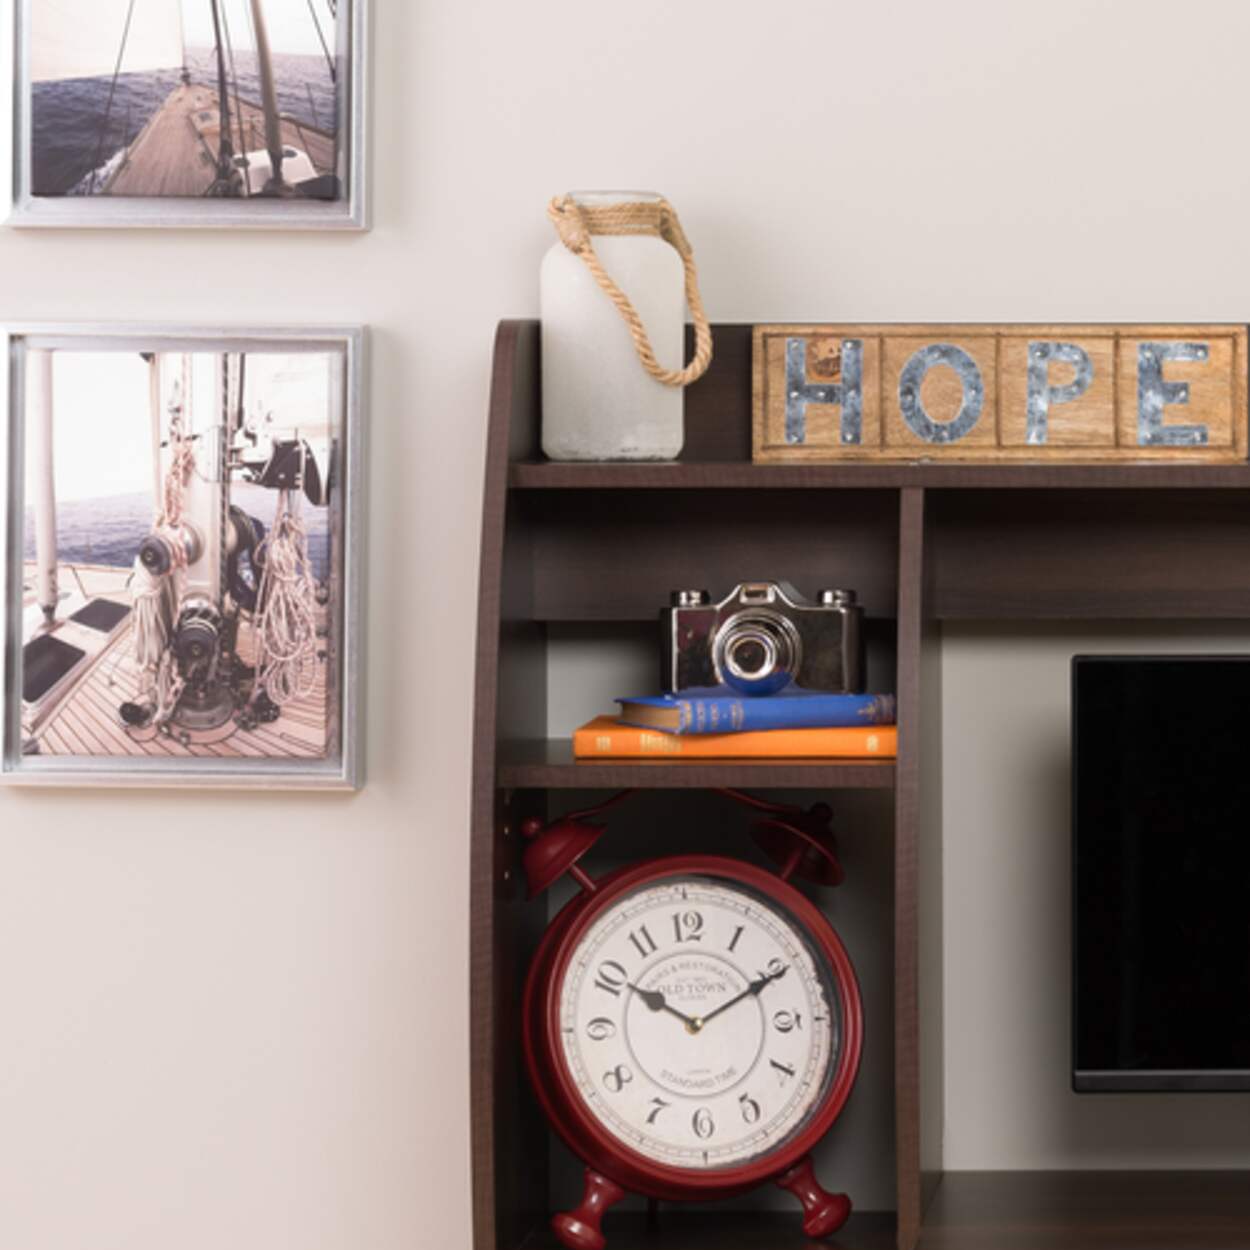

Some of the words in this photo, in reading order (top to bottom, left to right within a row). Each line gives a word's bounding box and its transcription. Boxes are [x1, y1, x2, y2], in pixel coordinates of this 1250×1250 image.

[785, 337, 1209, 445] HOPE
[628, 924, 658, 959] 11
[673, 910, 704, 943] 12
[727, 925, 745, 952] 1
[594, 960, 628, 997] 10
[657, 983, 685, 995] OLD
[687, 980, 727, 994] TOWN
[586, 1016, 616, 1041] 9
[602, 1063, 633, 1093] 8
[646, 1097, 671, 1125] 7
[692, 1106, 715, 1140] 6
[738, 1092, 762, 1124] 5
